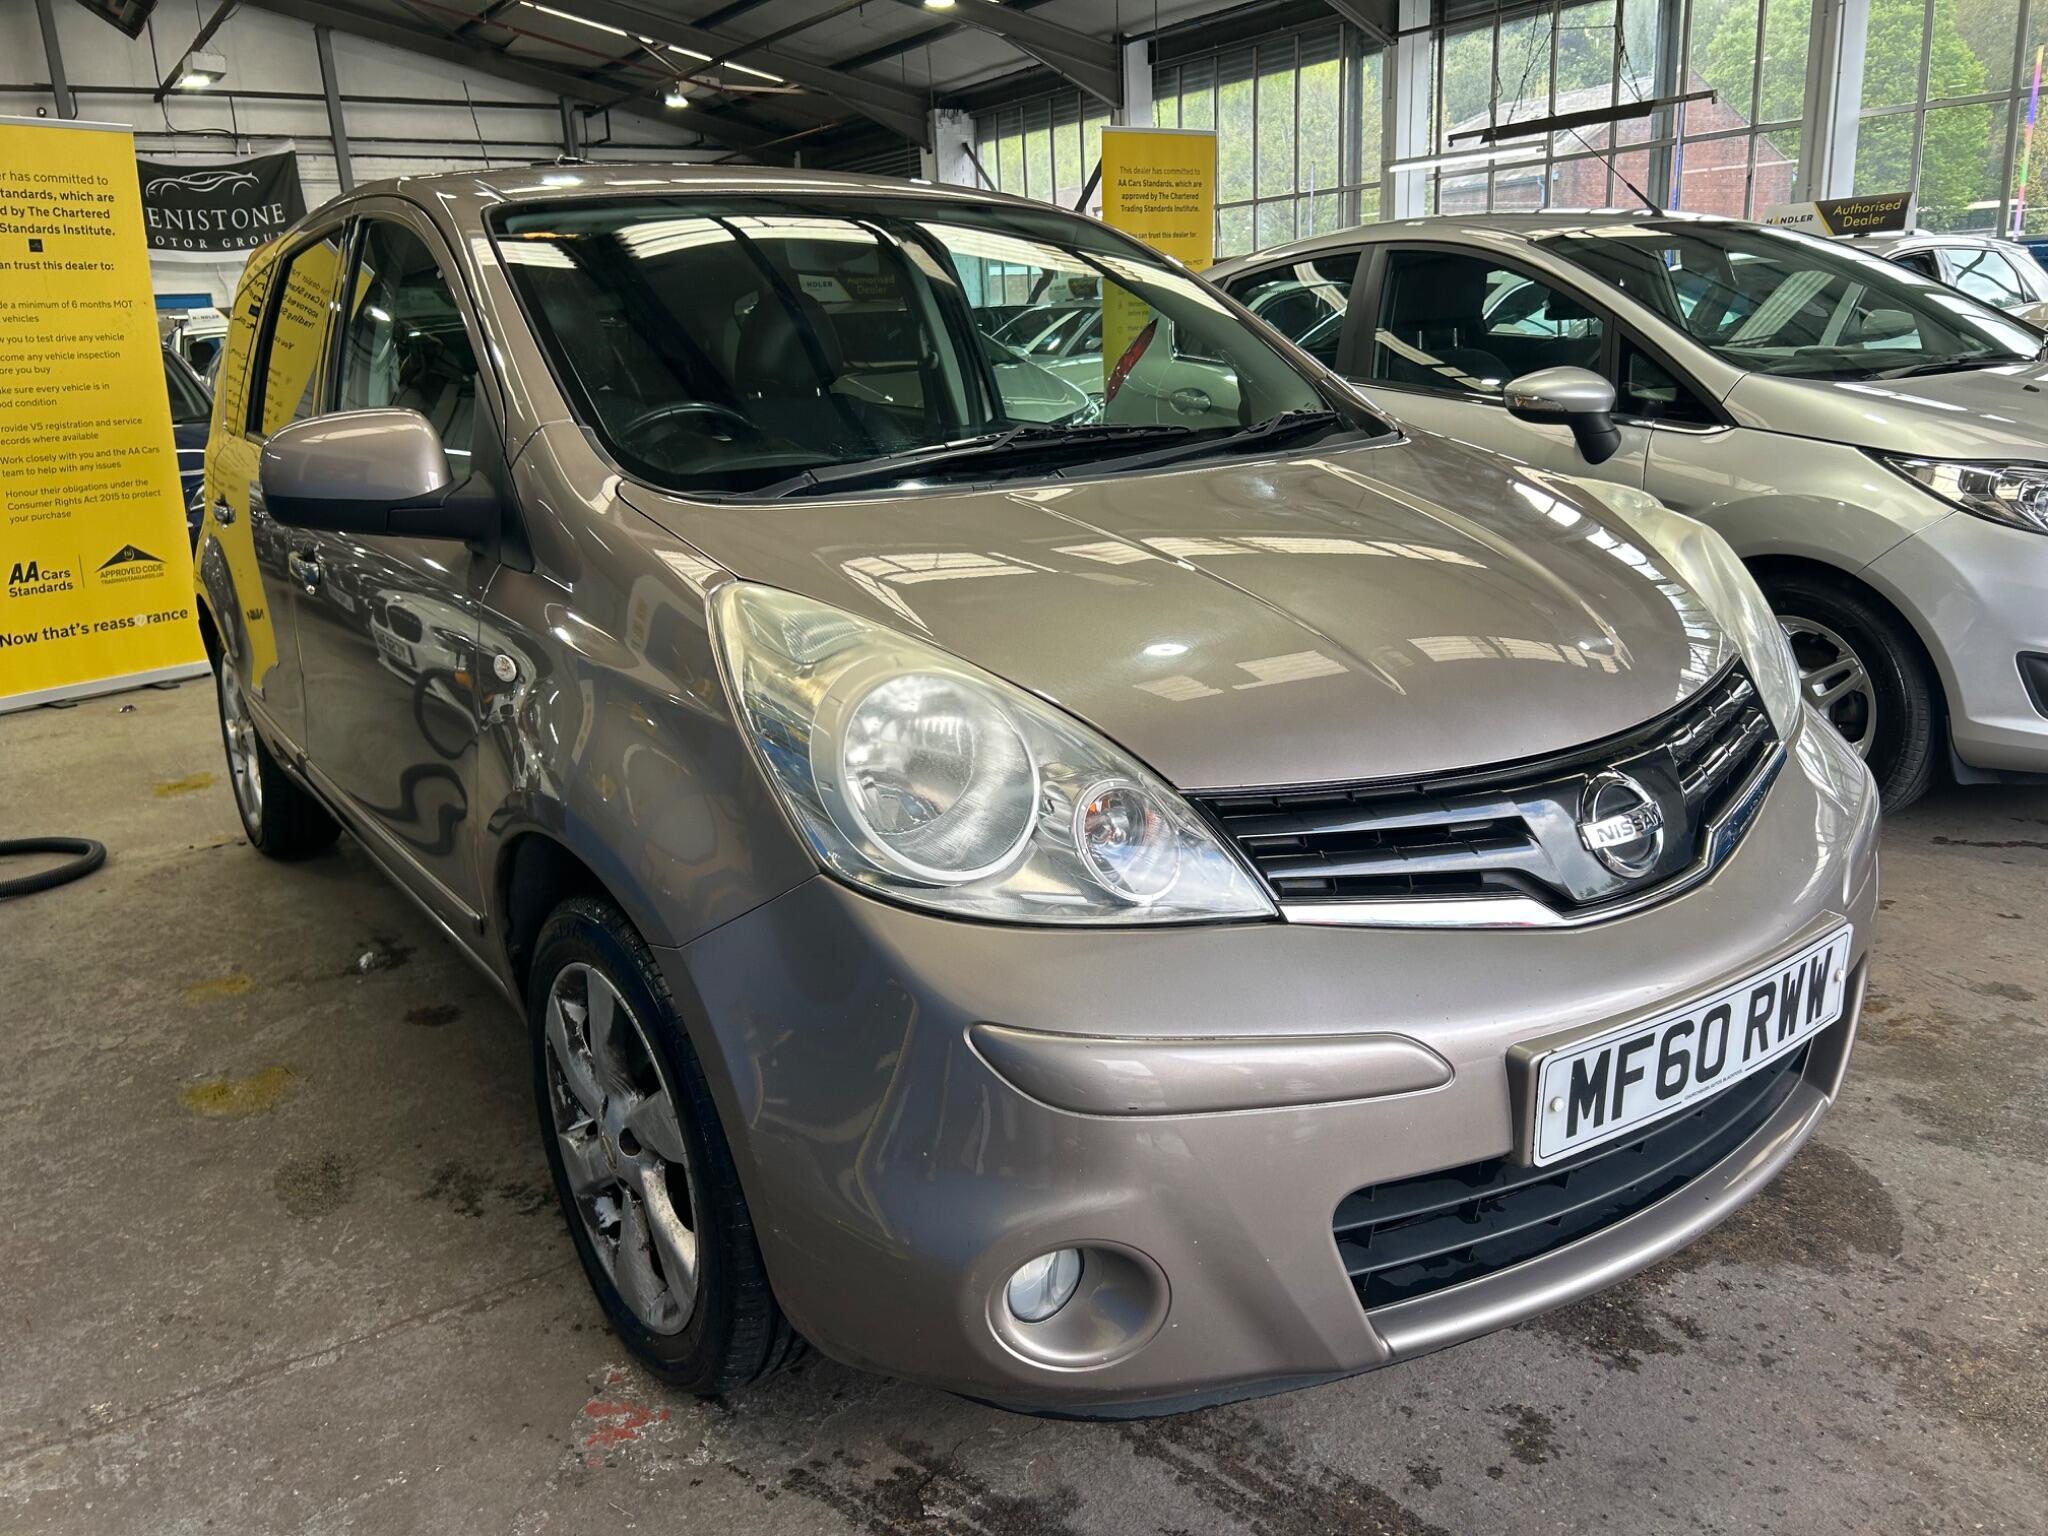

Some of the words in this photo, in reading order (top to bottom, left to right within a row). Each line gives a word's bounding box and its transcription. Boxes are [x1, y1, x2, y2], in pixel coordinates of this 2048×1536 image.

[10, 171, 31, 182] has
[33, 173, 94, 185] committed
[97, 175, 109, 186] to
[59, 190, 94, 202] which
[96, 194, 115, 203] are
[10, 206, 25, 218] by
[27, 206, 50, 217] The
[52, 207, 110, 219] Chartered
[1833, 199, 1902, 216] Authorised
[1843, 213, 1886, 228] Dealer
[0, 223, 61, 234] Standards
[63, 224, 116, 236] Institute.
[14, 261, 41, 270] trust
[43, 261, 63, 270] this
[65, 261, 98, 270] dealer
[100, 261, 115, 271] to:
[18, 300, 59, 309] minimum
[61, 300, 70, 309] of
[71, 300, 78, 309] 6
[79, 300, 112, 309] months
[113, 300, 133, 309] MOT
[2, 314, 40, 323] vehicles
[7, 336, 23, 345] you
[25, 335, 35, 343] to
[36, 334, 54, 343] test
[55, 333, 77, 343] drive
[78, 335, 93, 344] any
[95, 333, 125, 342] vehicle
[27, 354, 43, 362] any
[45, 351, 75, 360] vehicle
[76, 350, 121, 361] inspection
[15, 367, 32, 375] you
[34, 366, 51, 375] buy
[14, 386, 34, 394] sure
[36, 385, 60, 394] every
[61, 383, 91, 392] vehicle
[102, 382, 110, 390] in
[15, 398, 57, 408] condition
[30, 422, 43, 431] V5
[45, 420, 94, 432] registration
[95, 418, 111, 427] and
[112, 417, 143, 426] service
[32, 434, 61, 443] where
[62, 432, 99, 442] available
[0, 453, 24, 465] Work
[25, 453, 57, 464] closely
[58, 451, 77, 461] with
[79, 451, 94, 460] you
[95, 448, 111, 458] and
[112, 447, 126, 456] the
[127, 446, 141, 455] AA
[142, 446, 160, 455] Cars
[2, 469, 25, 478] team
[26, 467, 36, 476] to
[37, 465, 57, 476] help
[59, 463, 78, 473] with
[79, 463, 94, 472] any
[95, 461, 122, 470] issues
[5, 489, 38, 499] Honour
[40, 486, 60, 496] their
[62, 482, 108, 495] obligations
[110, 480, 133, 490] under
[135, 479, 149, 488] the
[7, 499, 52, 511] Consumer
[54, 496, 82, 508] Rights
[83, 495, 99, 504] Act
[100, 493, 121, 503] 2015
[121, 491, 130, 500] to
[131, 488, 162, 500] protect
[9, 515, 29, 525] your
[31, 510, 72, 522] purchase
[8, 561, 40, 586] AA
[41, 569, 71, 581] Cars
[101, 567, 142, 579] APPROVED
[142, 564, 164, 573] CODE
[9, 580, 74, 598] Standards
[0, 631, 38, 648] Now
[93, 608, 189, 632] reassrance
[1596, 805, 1662, 842] NISSAN
[1566, 1003, 1732, 1139] MF60
[1742, 946, 1832, 1062] RWW
